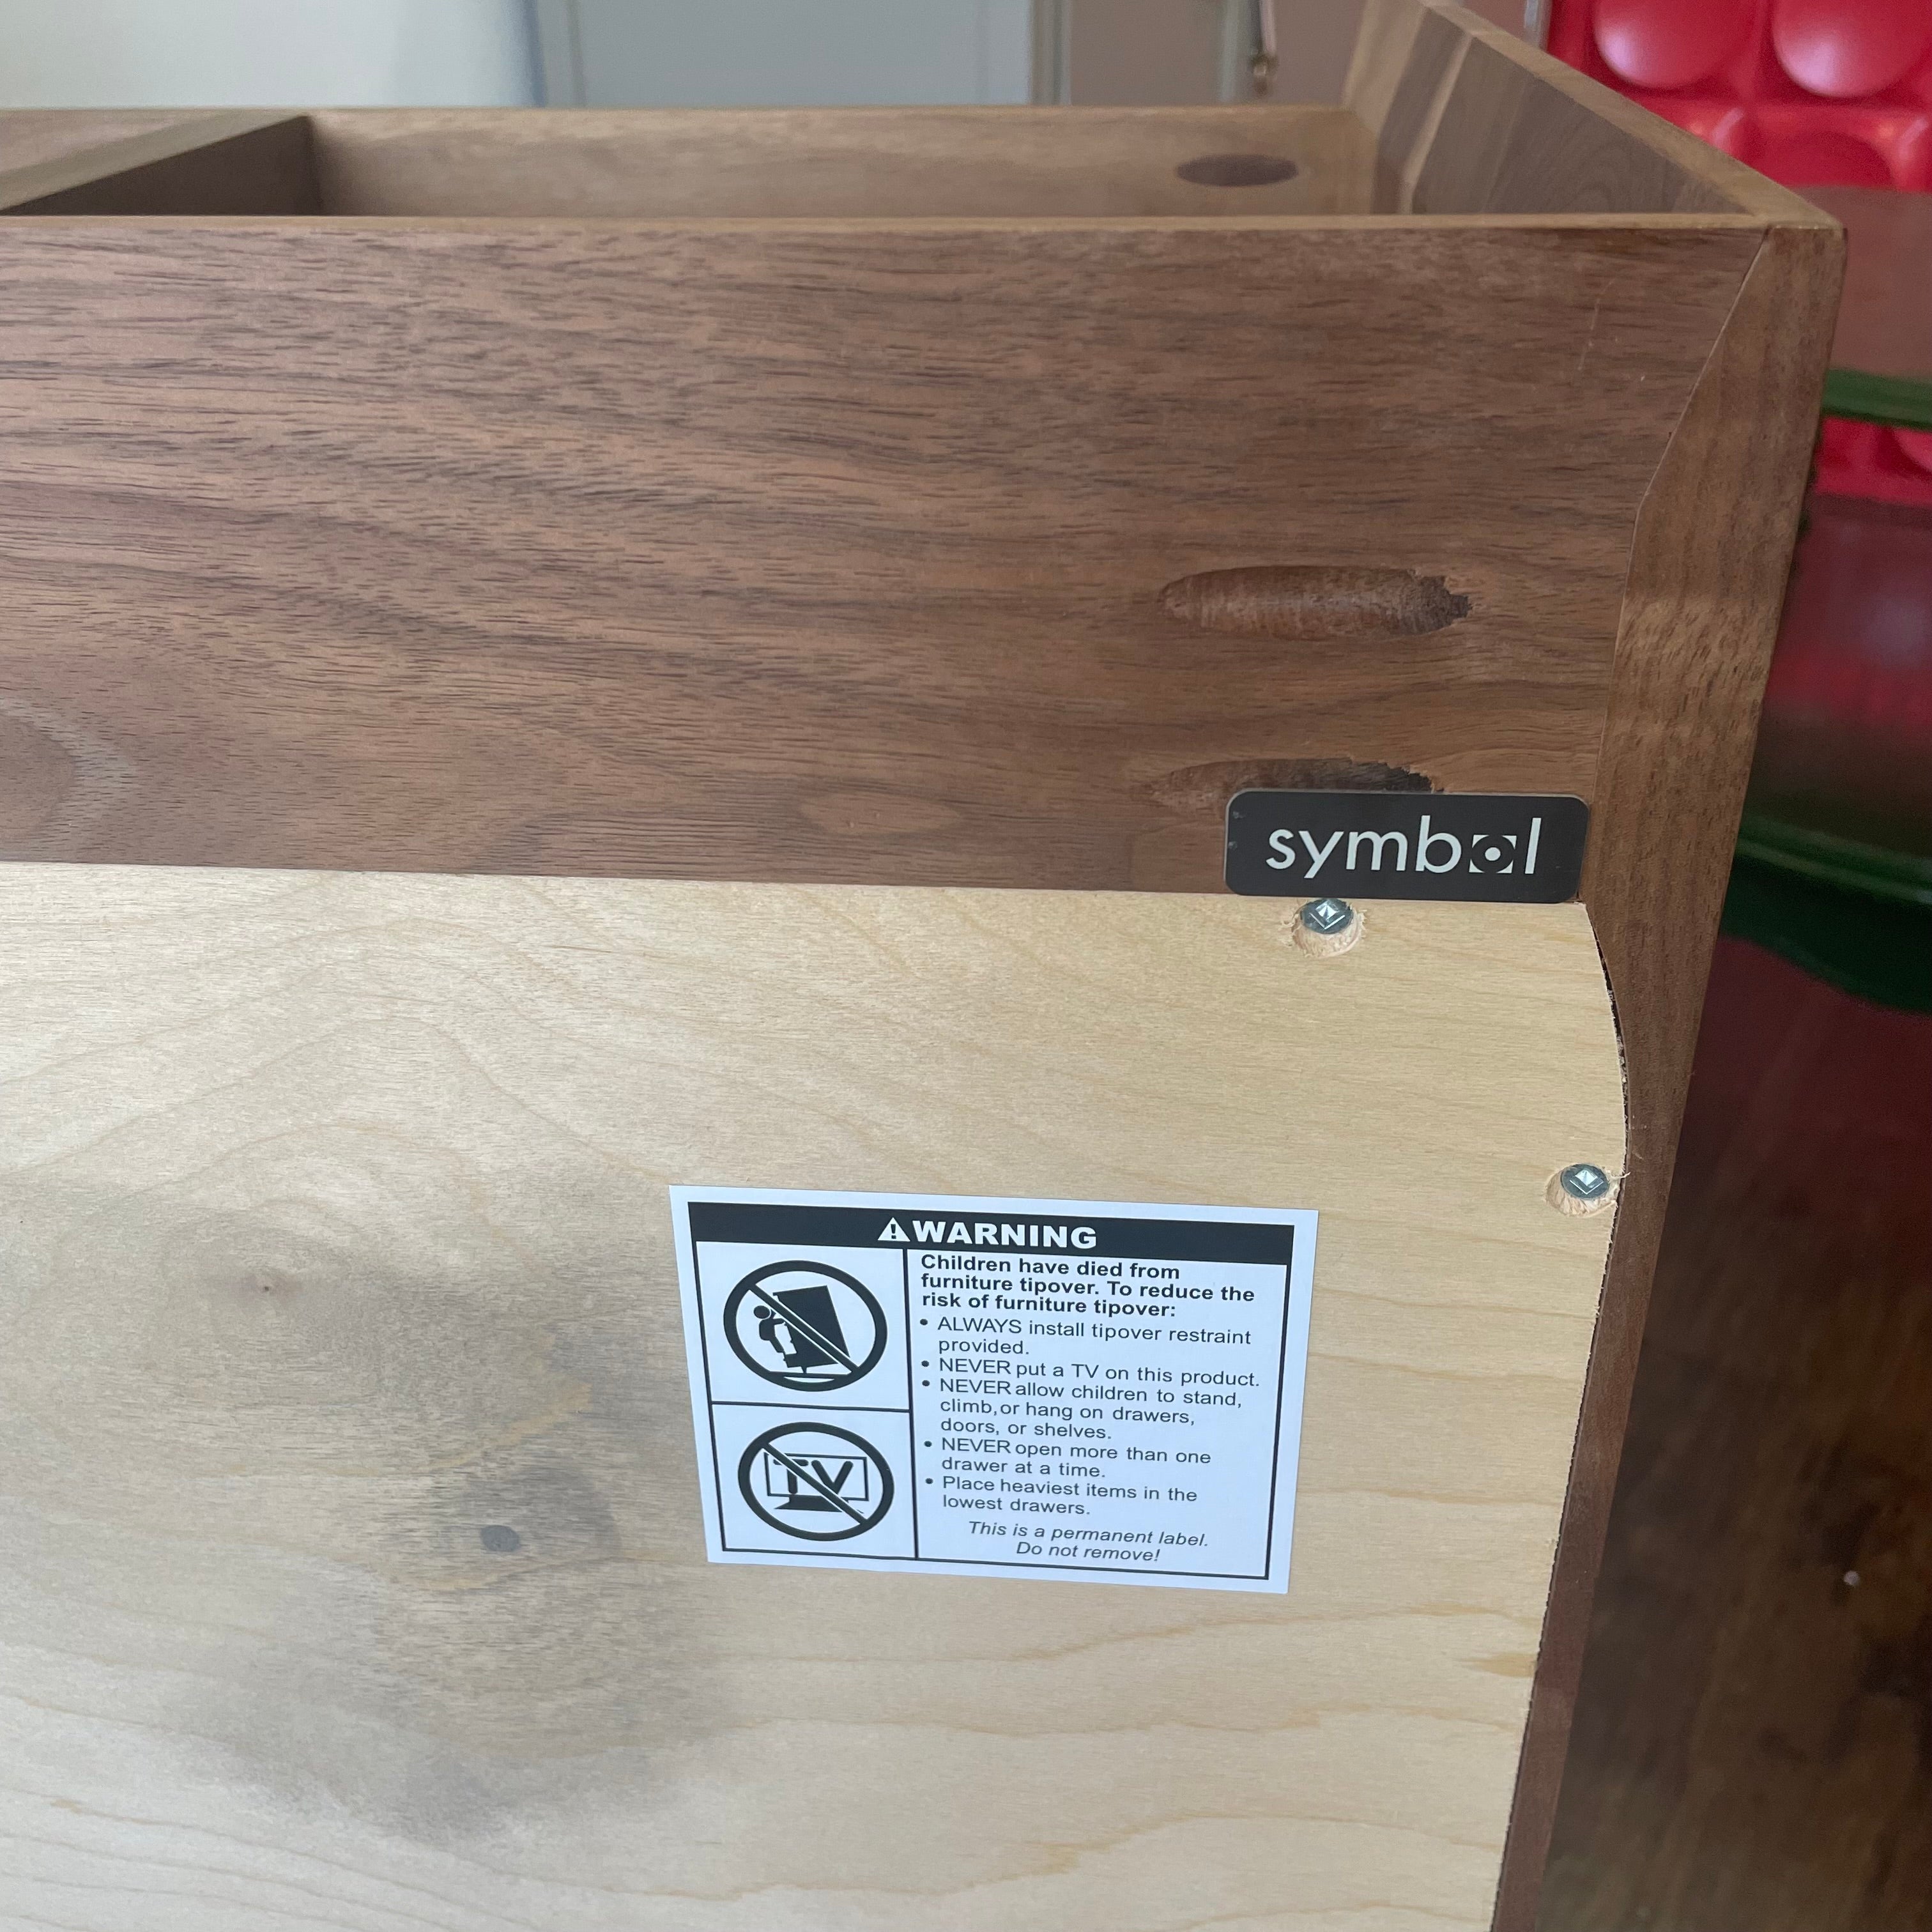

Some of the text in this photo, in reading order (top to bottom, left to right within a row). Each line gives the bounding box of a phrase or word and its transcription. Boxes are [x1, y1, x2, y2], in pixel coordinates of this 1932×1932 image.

[1266, 815, 1542, 879] symbol
[912, 1220, 1097, 1250] WARNING
[921, 1254, 1179, 1280] Children have died from
[921, 1273, 1255, 1302] furniture tipover. To reduce the
[923, 1292, 1176, 1318] risk of furniture tipover:
[937, 1316, 1252, 1345] ALWAYS install tipover restraint
[939, 1338, 1029, 1355] provided.
[940, 1357, 1259, 1386] NEVER put a TV on this product.
[940, 1377, 1241, 1409] NEVER allow children to stand,
[1026, 1402, 1073, 1421] hang
[1080, 1407, 1103, 1419] on
[1112, 1406, 1194, 1426] drawers,
[940, 1418, 1111, 1439] doors, or shelves.
[942, 1437, 1211, 1464] NEVER open more than one
[942, 1456, 1105, 1478] drawer at a time.
[943, 1475, 1197, 1502] Place heaviest items in the
[943, 1494, 1090, 1515] lowest drawers.
[969, 1521, 1208, 1547] This is a permanent label.
[1016, 1541, 1161, 1561] Do not remove!
